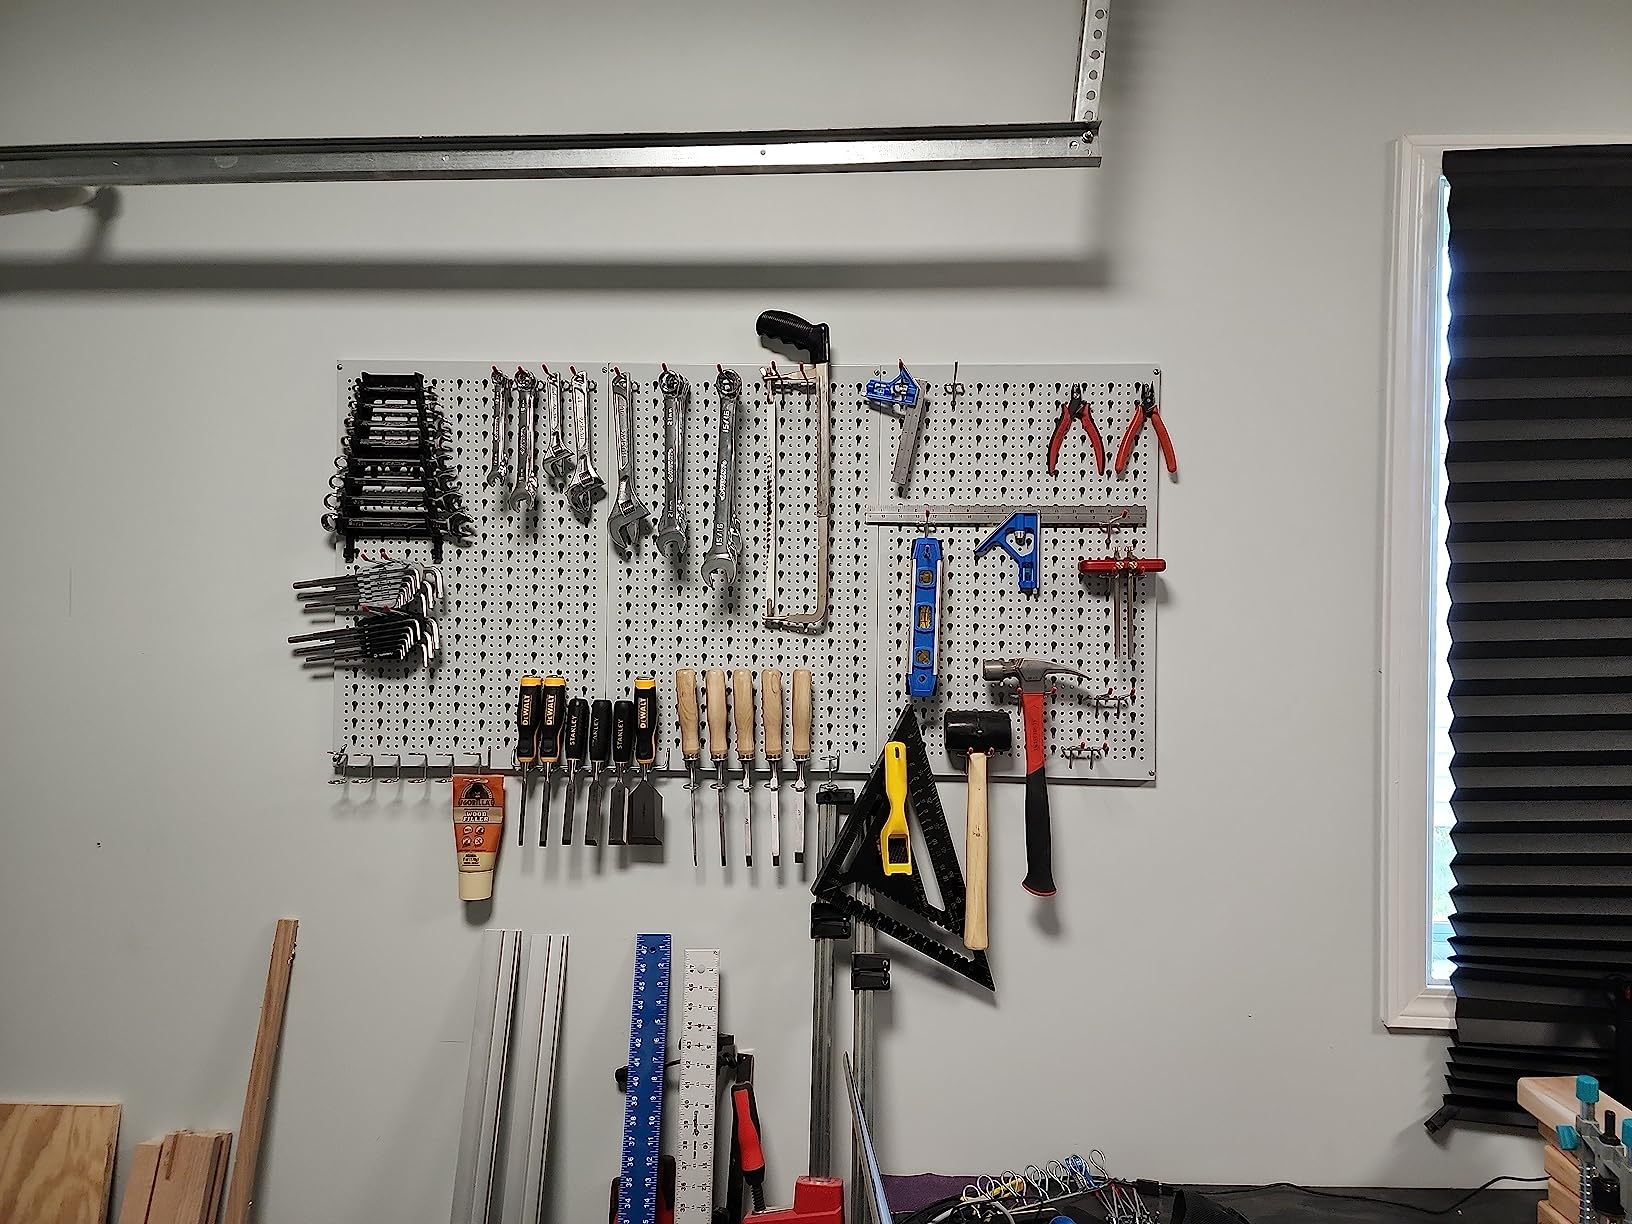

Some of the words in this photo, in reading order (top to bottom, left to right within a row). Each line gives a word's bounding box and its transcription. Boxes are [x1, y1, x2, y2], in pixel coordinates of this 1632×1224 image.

[722, 410, 730, 433] 15/16
[715, 523, 724, 546] 15/16
[569, 715, 578, 746] STANLEY
[642, 945, 648, 954] 47
[640, 964, 646, 972] 46
[639, 981, 645, 991] 45
[638, 1000, 644, 1009] 44
[637, 1019, 643, 1028] 43
[636, 1038, 642, 1047] 42
[634, 1057, 640, 1067] 41
[632, 1076, 639, 1087] 40
[631, 1096, 638, 1106] 39
[630, 1116, 637, 1126] 38
[648, 1116, 655, 1125] 10
[629, 1136, 635, 1146] 37
[647, 1137, 653, 1146] 11
[627, 1156, 634, 1167] 36
[646, 1156, 653, 1166] 12
[625, 1177, 632, 1188] 35
[645, 1178, 652, 1187] 13
[624, 1198, 631, 1209] 34
[643, 1198, 650, 1208] 14
